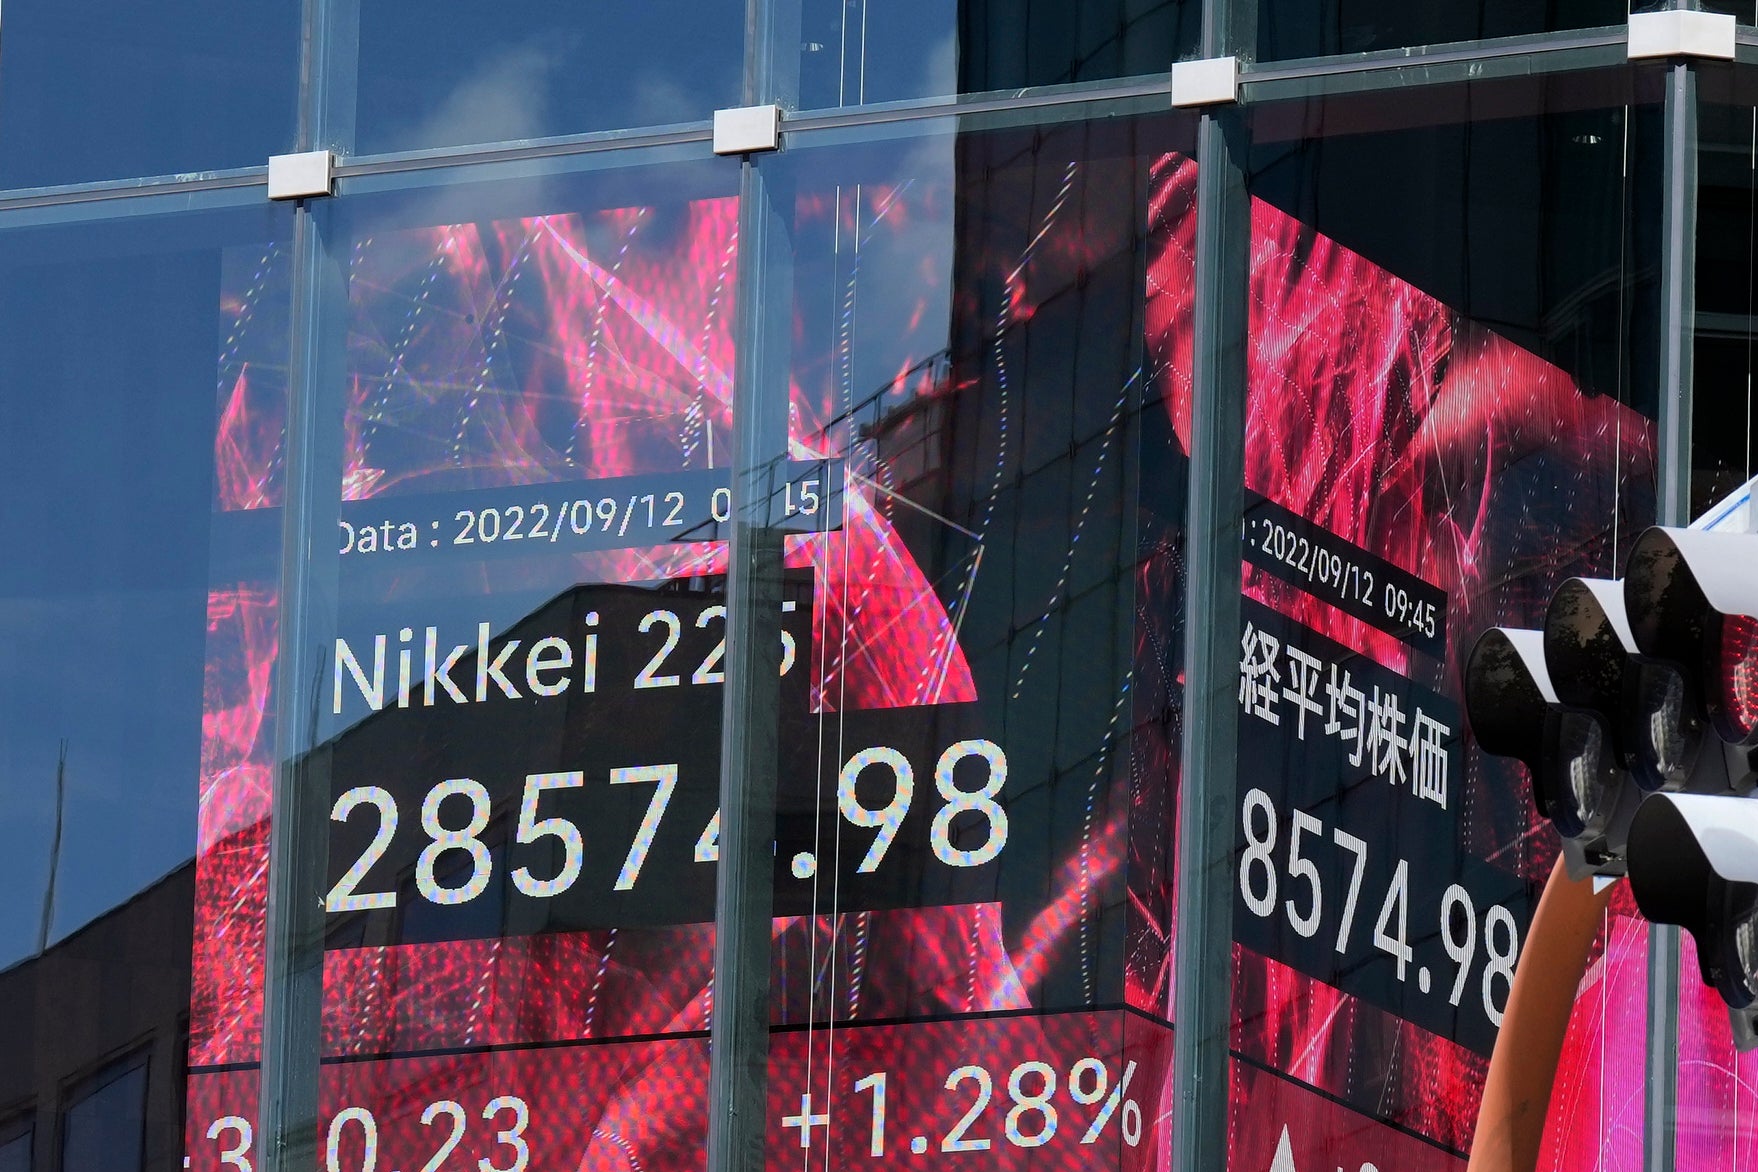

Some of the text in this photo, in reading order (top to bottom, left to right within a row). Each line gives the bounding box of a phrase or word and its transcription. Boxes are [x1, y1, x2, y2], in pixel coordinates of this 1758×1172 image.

[454, 491, 684, 544] 2022/09/12
[1262, 518, 1373, 607] 2022/09/12
[1384, 582, 1436, 638] 09:45
[333, 611, 600, 713] Nikkei
[1238, 620, 1451, 810] 経平均株価
[1239, 788, 1517, 1028] 8574.98
[782, 1058, 1142, 1158] +1.28%
